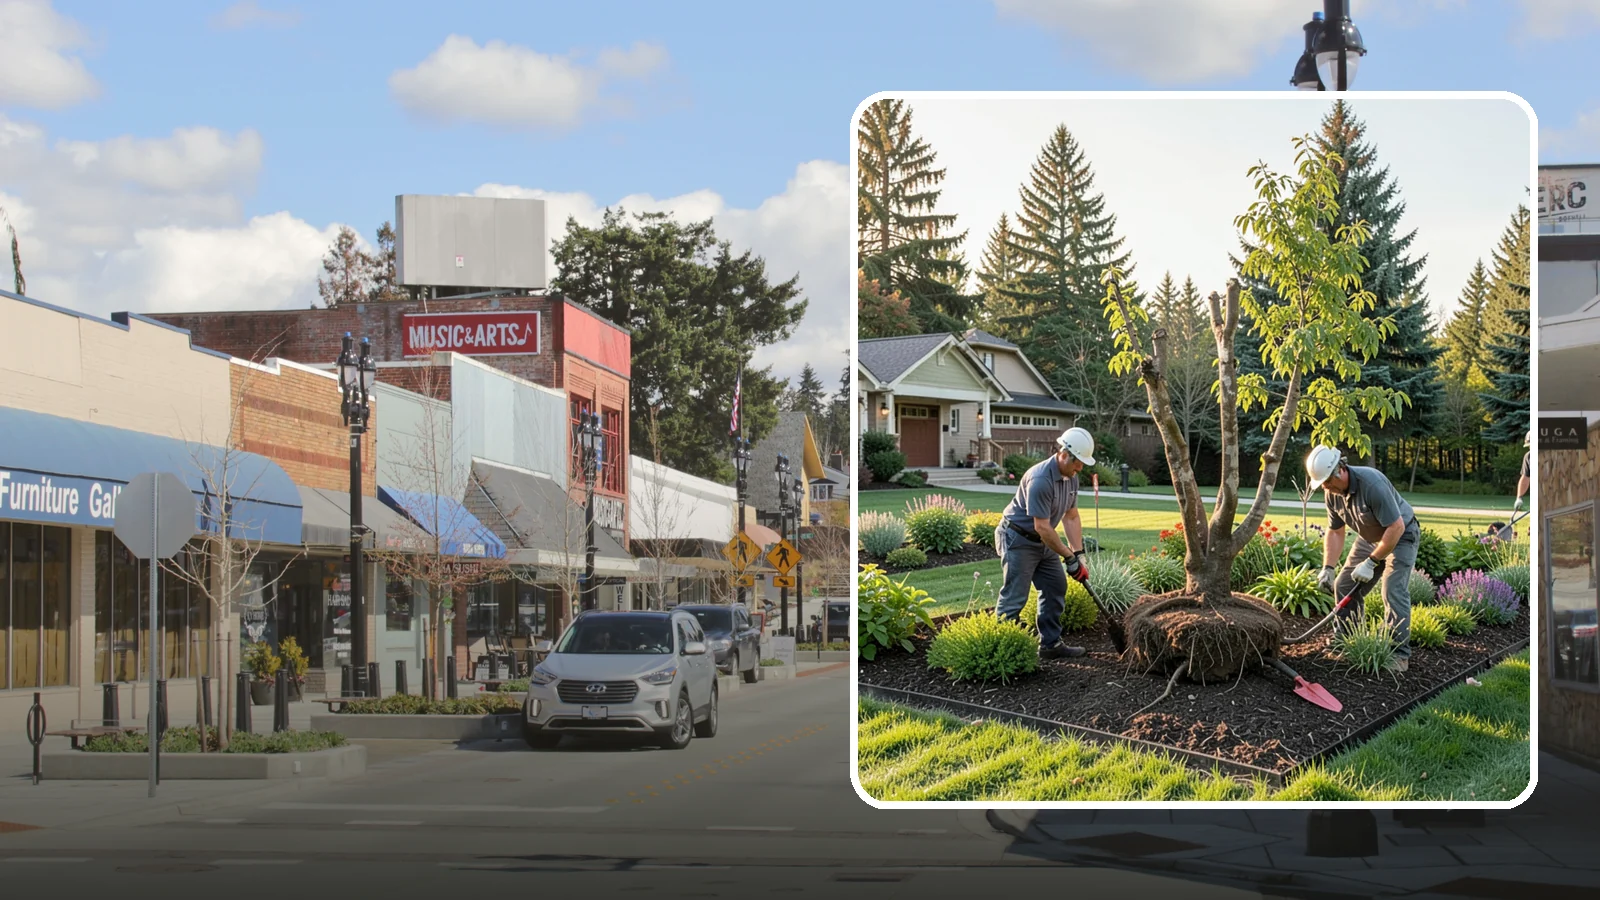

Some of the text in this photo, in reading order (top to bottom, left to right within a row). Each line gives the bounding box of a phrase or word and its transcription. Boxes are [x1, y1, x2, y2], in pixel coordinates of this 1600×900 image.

[408, 323, 519, 348] MUSIC&ARTS
[0, 471, 121, 518] Furniture Gal
[453, 562, 480, 574] SUSHI
